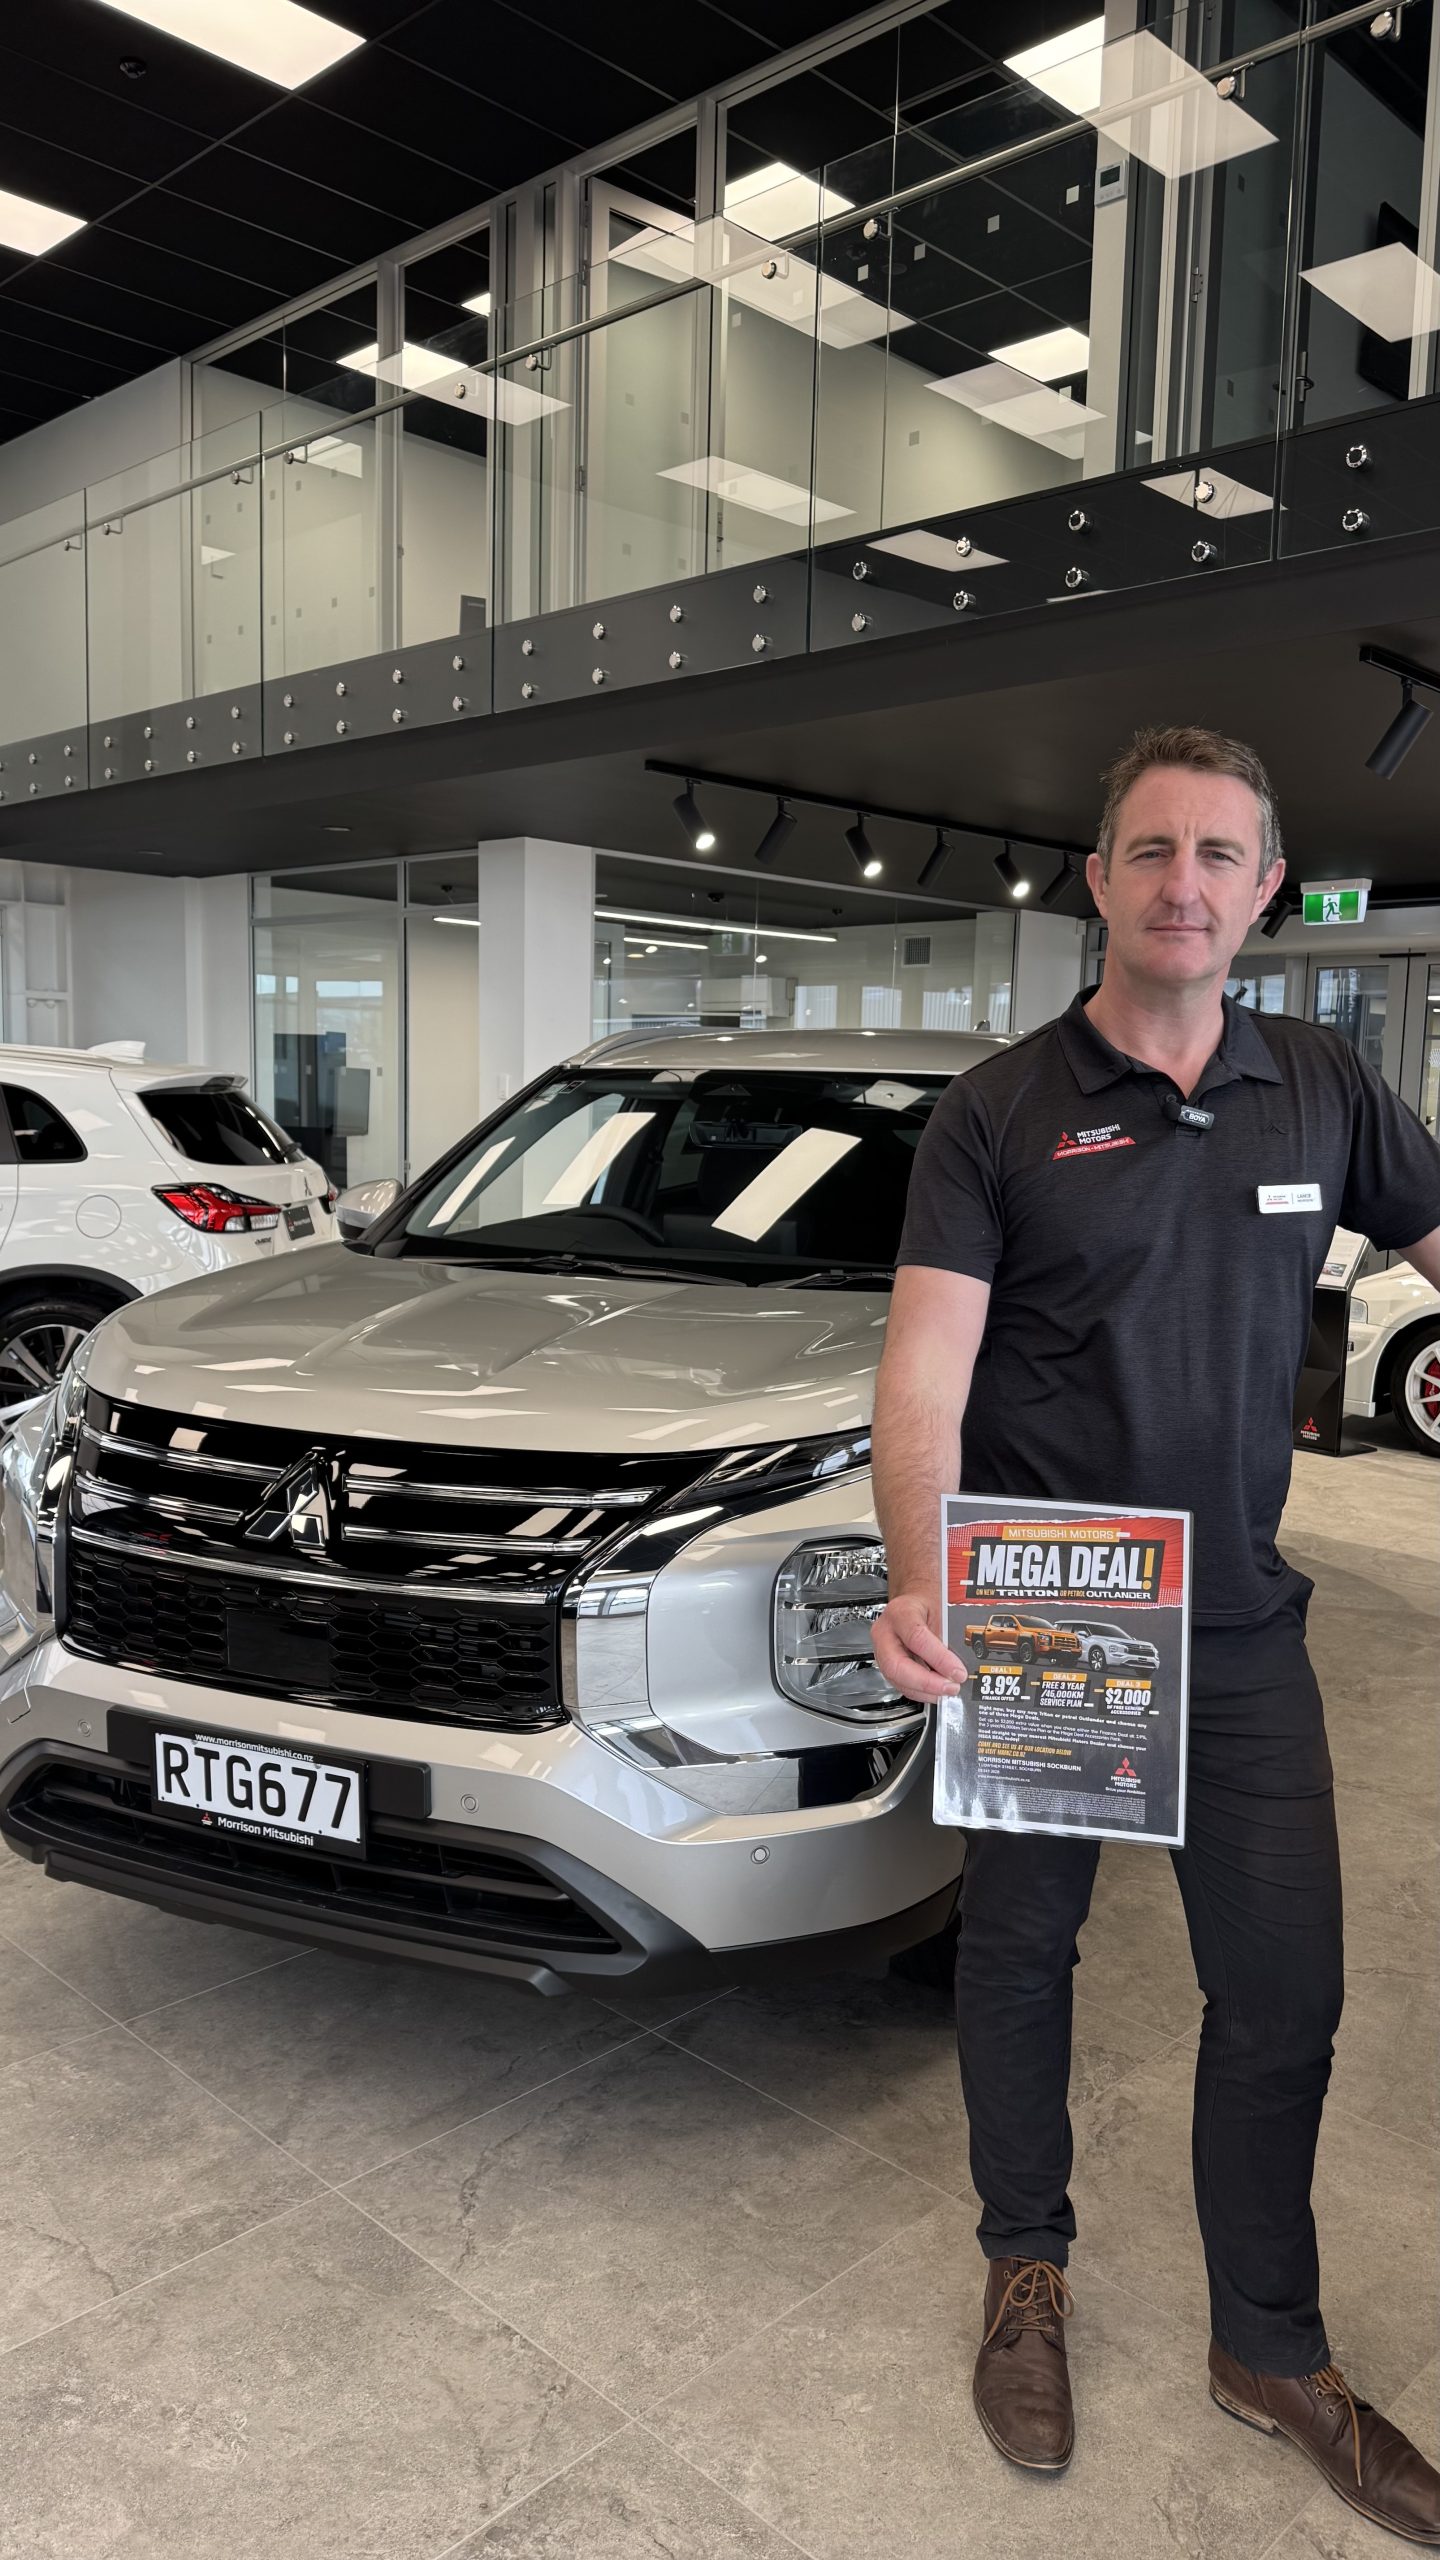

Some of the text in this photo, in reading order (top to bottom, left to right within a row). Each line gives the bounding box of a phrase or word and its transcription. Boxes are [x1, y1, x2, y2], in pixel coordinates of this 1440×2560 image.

[1189, 1114, 1205, 1123] BOYA
[1077, 1124, 1121, 1138] MITSUBISHI
[1078, 1133, 1112, 1144] MOTORS
[1057, 1147, 1090, 1156] MORRISON
[1094, 1139, 1130, 1150] MITSUBISHI
[1008, 1528, 1113, 1539] MITSUBISHI MOTORS
[977, 1544, 1154, 1590] MEGA DEAL!
[1086, 1590, 1151, 1599] OUTLANDER
[981, 1675, 1020, 1696] 3.9%
[1042, 1681, 1058, 1689] FREE
[1067, 1682, 1085, 1690] YEAR
[1041, 1690, 1084, 1699] /45,000KM
[1105, 1688, 1151, 1705] $2,000
[1040, 1699, 1065, 1707] SERVICE
[195, 1733, 314, 1762] www.morrisonmitsubishi.co.nz
[1012, 1759, 1046, 1768] MITSUBISHI
[1047, 1763, 1081, 1772] SOCKBURN
[162, 1741, 351, 1829] RTG677
[218, 1816, 314, 1846] Morrison Mitsubishi
